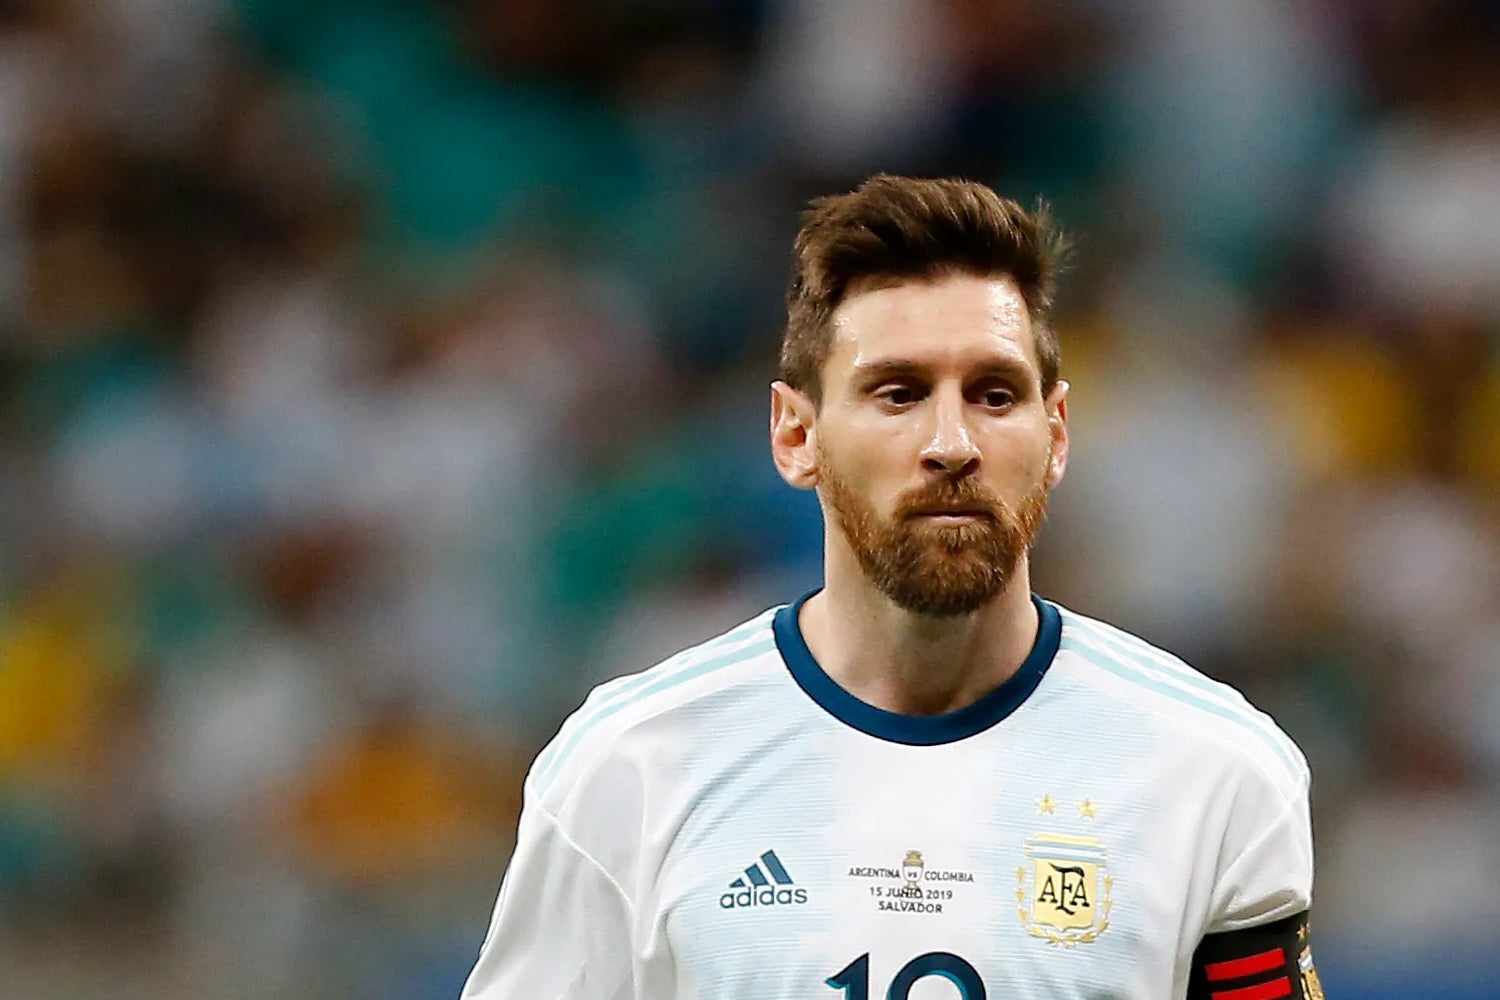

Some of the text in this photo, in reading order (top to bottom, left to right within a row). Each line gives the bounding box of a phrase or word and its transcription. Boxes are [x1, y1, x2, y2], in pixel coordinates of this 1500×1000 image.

[848, 867, 901, 879] ARGENTINA
[924, 870, 975, 883] COLOMBIA
[870, 886, 953, 901] 15 JUNIO 2019
[1037, 862, 1090, 916] AFA
[719, 885, 808, 910] adidas
[878, 901, 944, 914] SALVADOR
